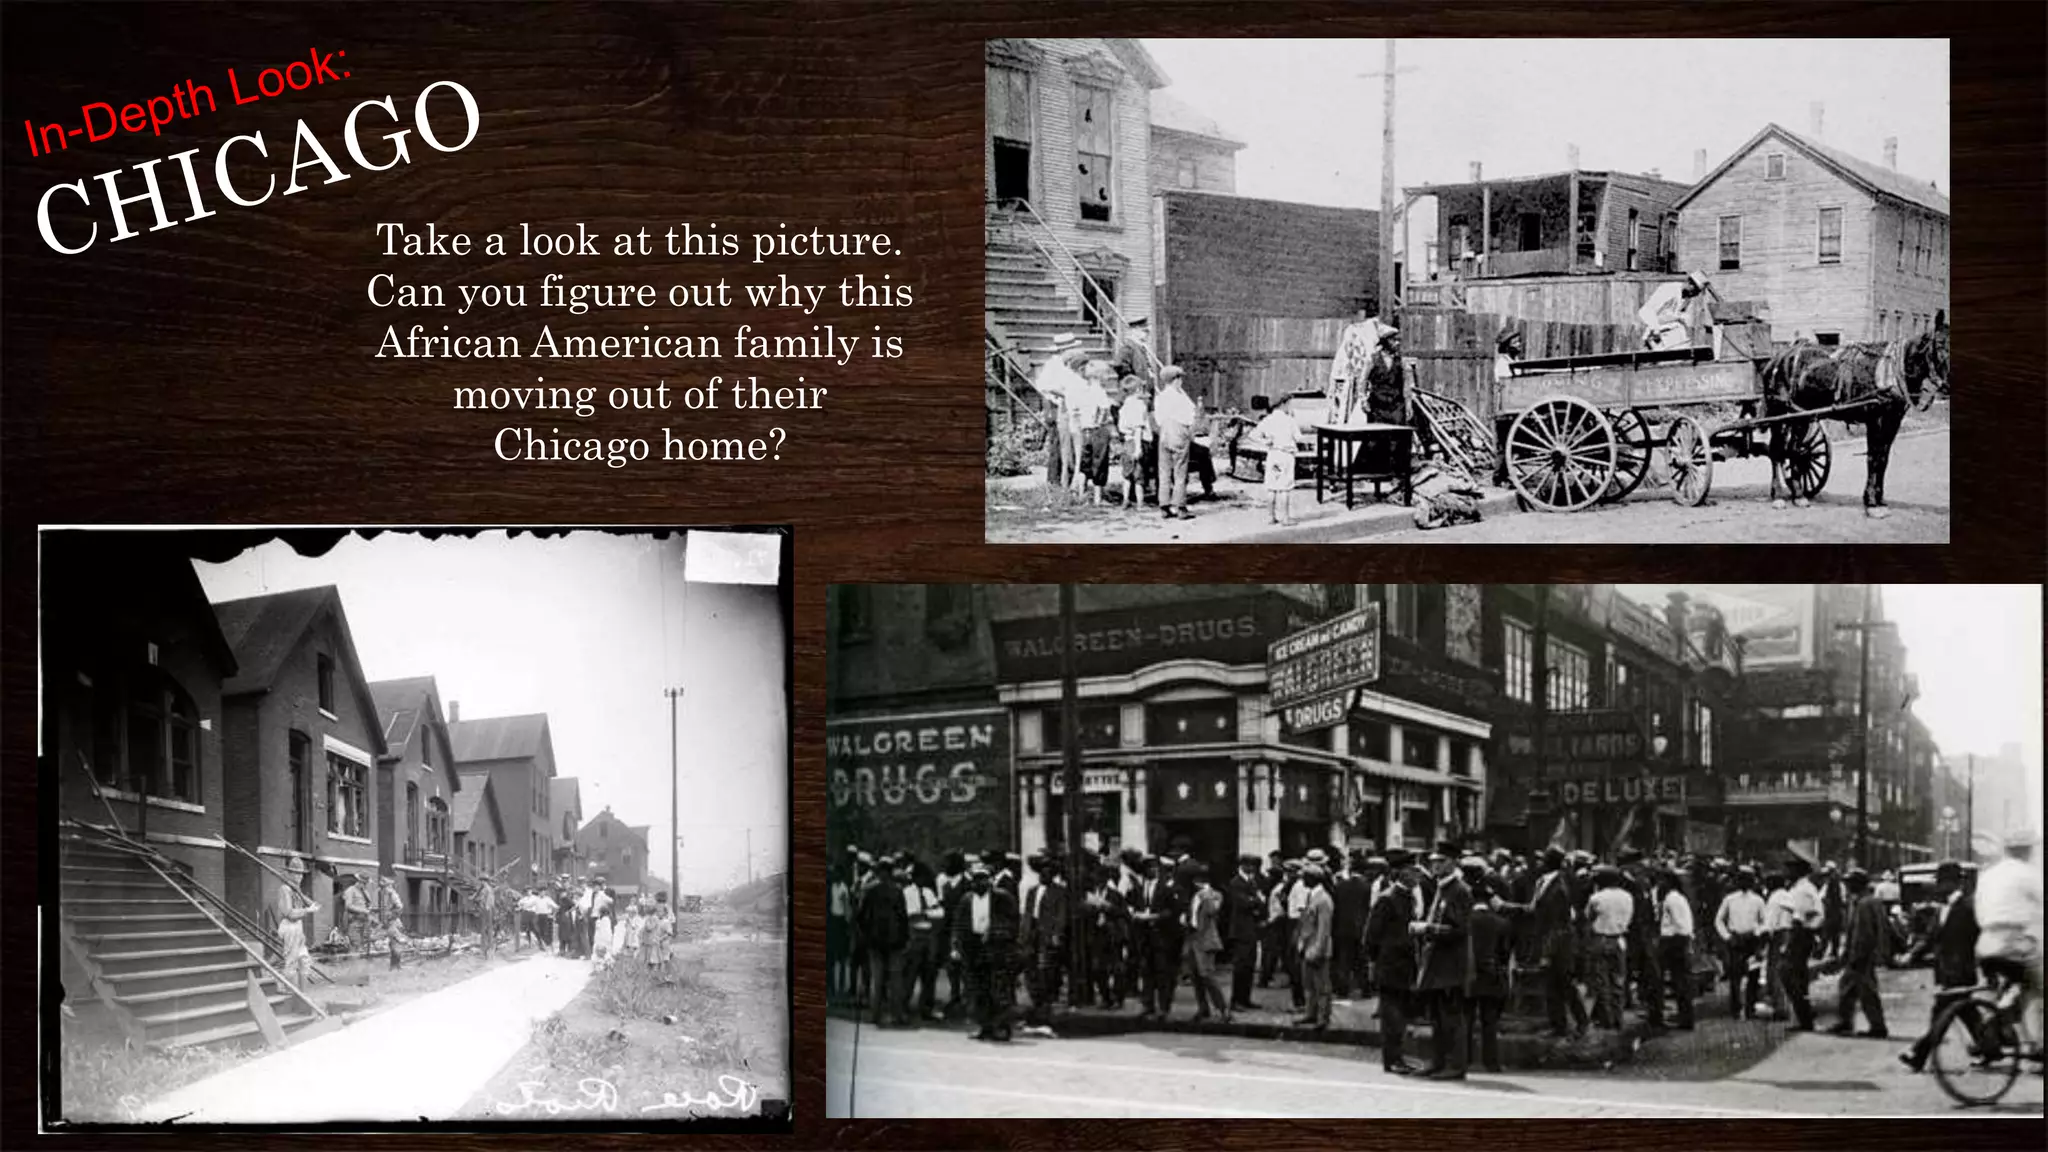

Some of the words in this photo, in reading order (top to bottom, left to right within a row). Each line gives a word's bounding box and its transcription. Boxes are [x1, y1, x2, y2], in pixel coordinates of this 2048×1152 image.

[1294, 697, 1342, 728] DRUGS
[827, 723, 993, 757] WALGREEN
[831, 760, 977, 807] DRUGS
